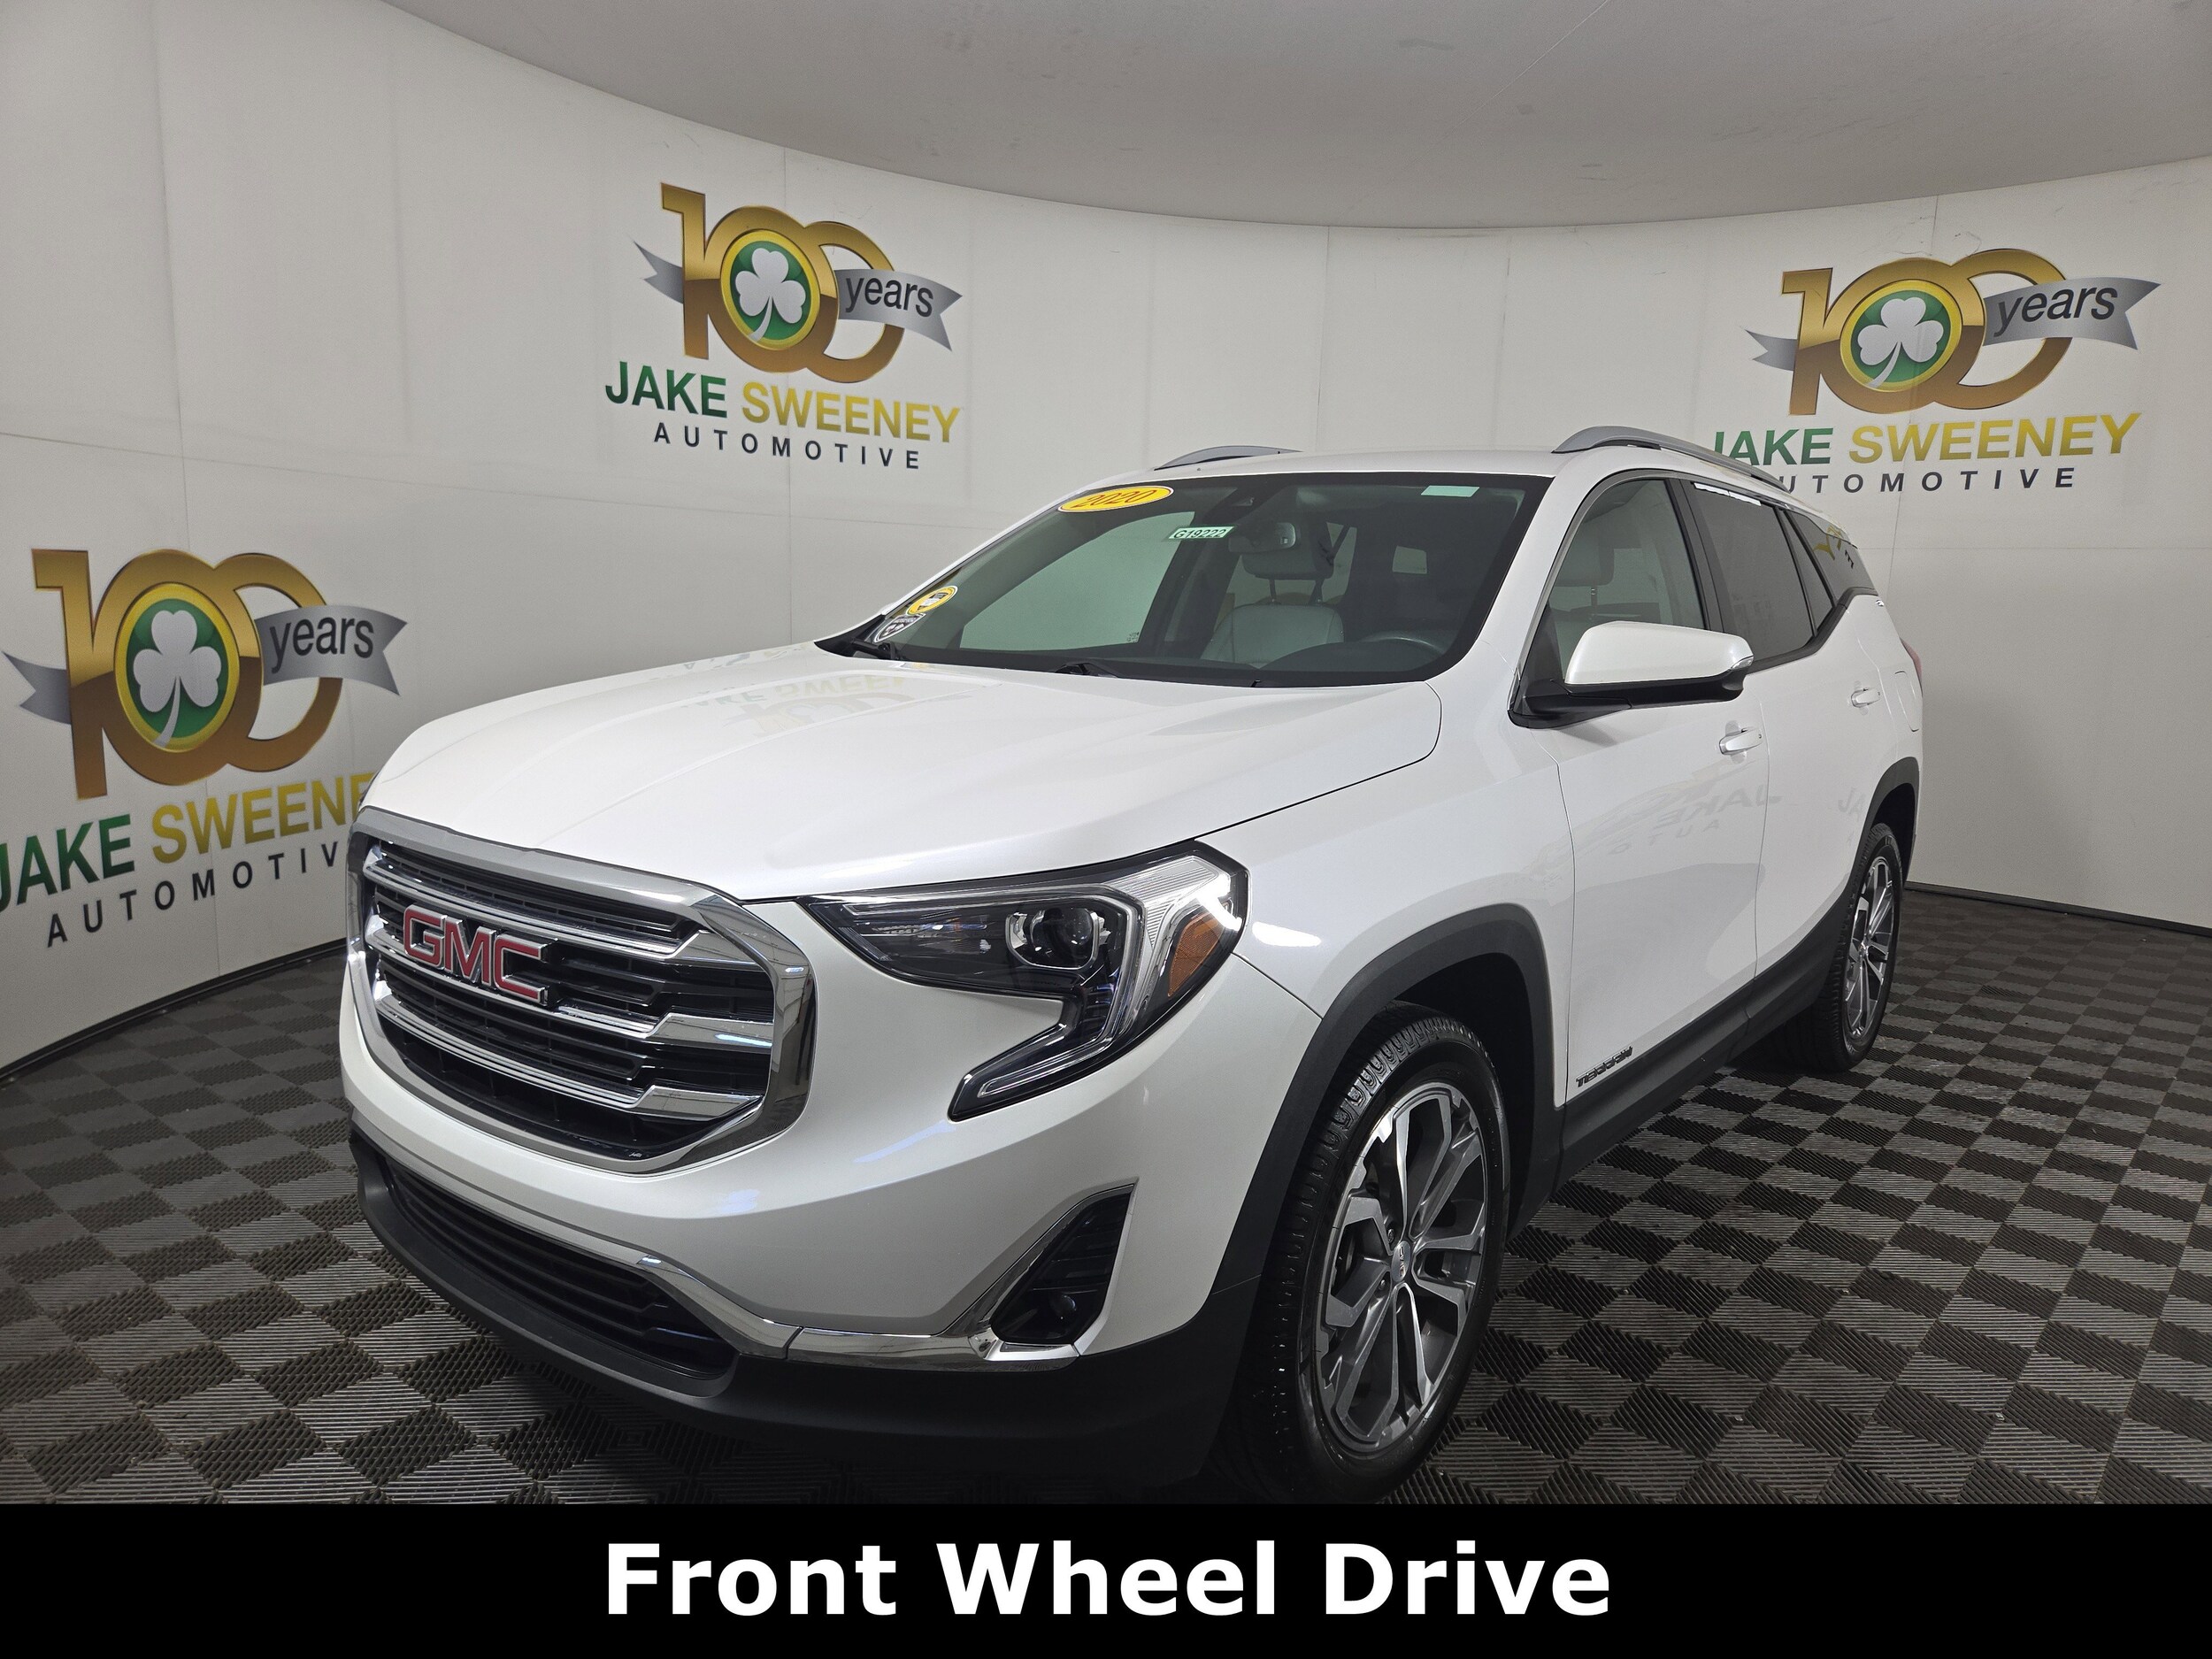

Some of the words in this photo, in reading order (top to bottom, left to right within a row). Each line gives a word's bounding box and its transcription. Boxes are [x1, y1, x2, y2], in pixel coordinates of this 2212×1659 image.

[660, 182, 905, 384] 100
[845, 276, 934, 318] years
[1780, 248, 2073, 416] 100
[1993, 281, 2118, 338] years
[605, 361, 727, 419] JAKE
[741, 381, 961, 443] SWEENEY
[1848, 411, 2143, 465] SWEENEY
[653, 422, 919, 470] AUTOMOTIVE
[1778, 467, 2076, 495] UTOMOTIVE
[1071, 489, 1157, 509] 2020
[1173, 528, 1227, 539] G19222
[31, 549, 344, 801] 100
[269, 616, 374, 674] years
[151, 772, 375, 864] SWEENE
[47, 841, 339, 949] AUTOMOTIV
[403, 903, 548, 1006] GMC
